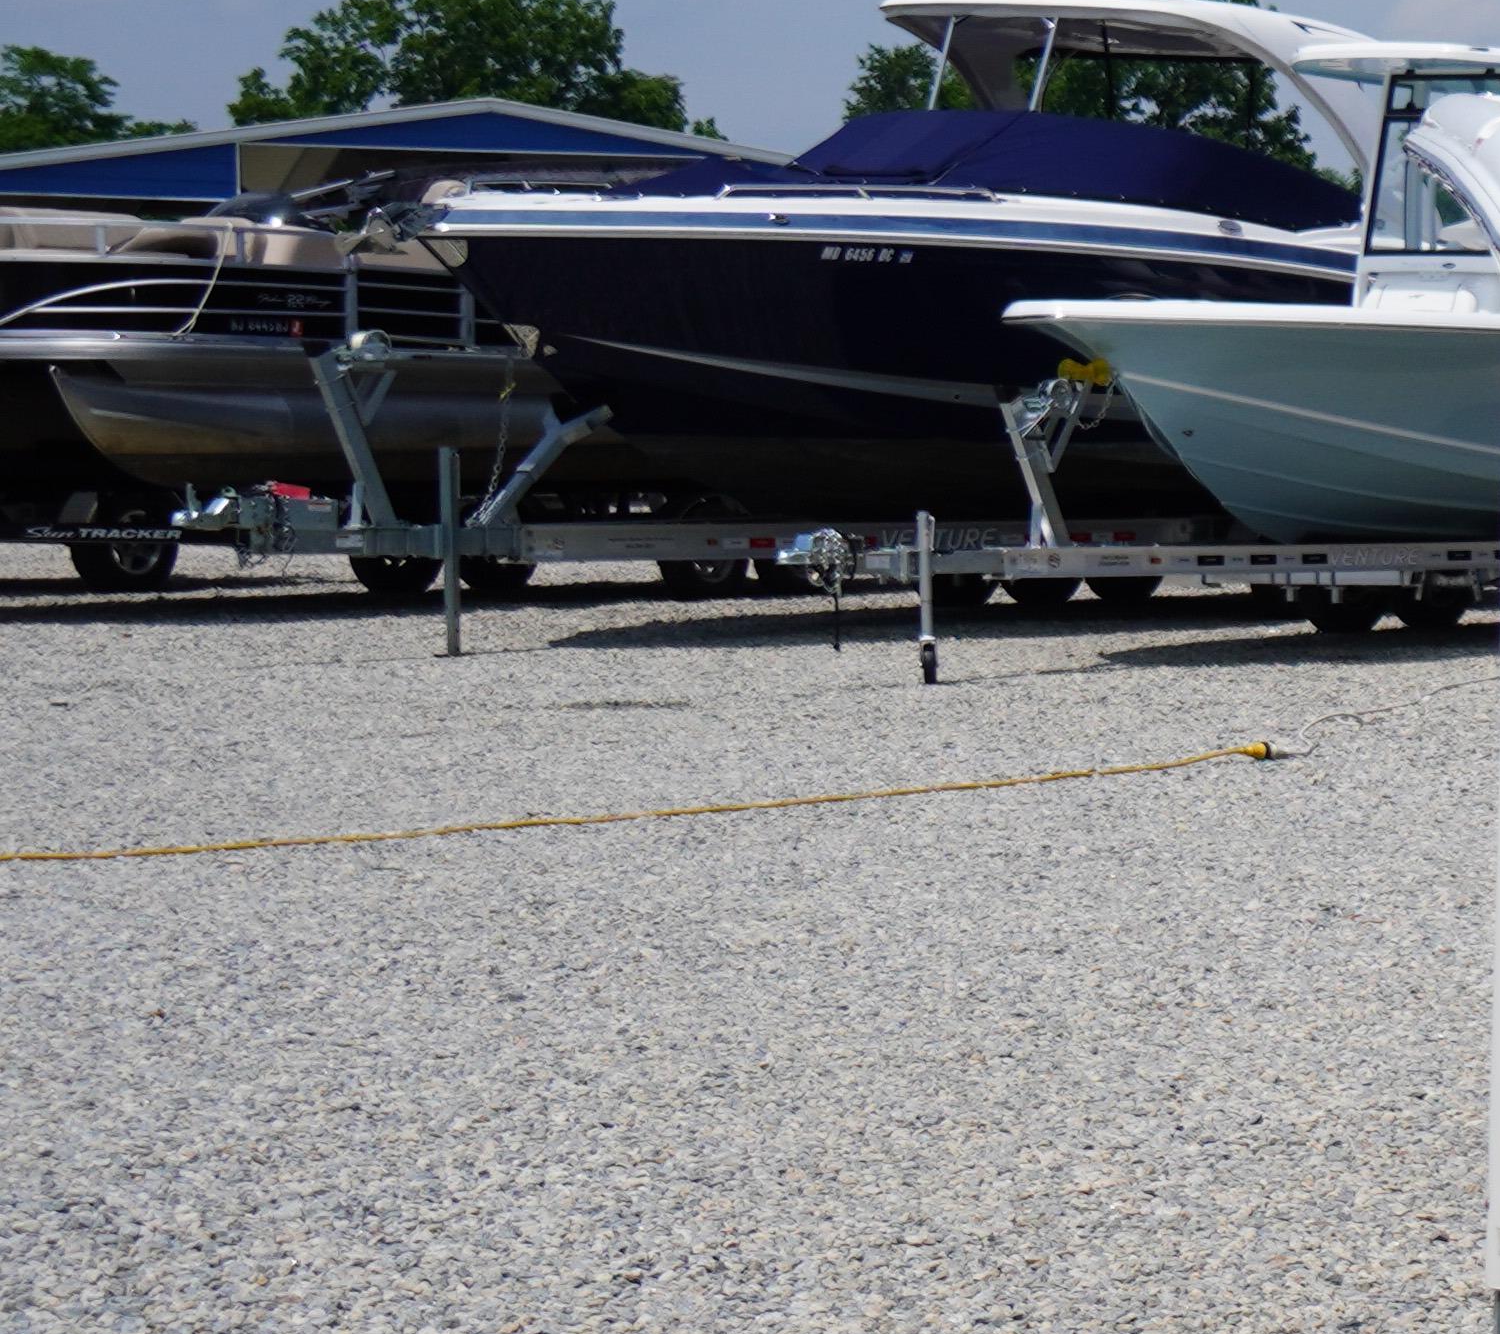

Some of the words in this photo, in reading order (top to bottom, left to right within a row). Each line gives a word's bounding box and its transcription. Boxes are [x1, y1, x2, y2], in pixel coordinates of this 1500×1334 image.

[79, 528, 183, 540] TRACKER
[881, 527, 998, 549] VETURE
[1329, 547, 1419, 566] VENTURE
